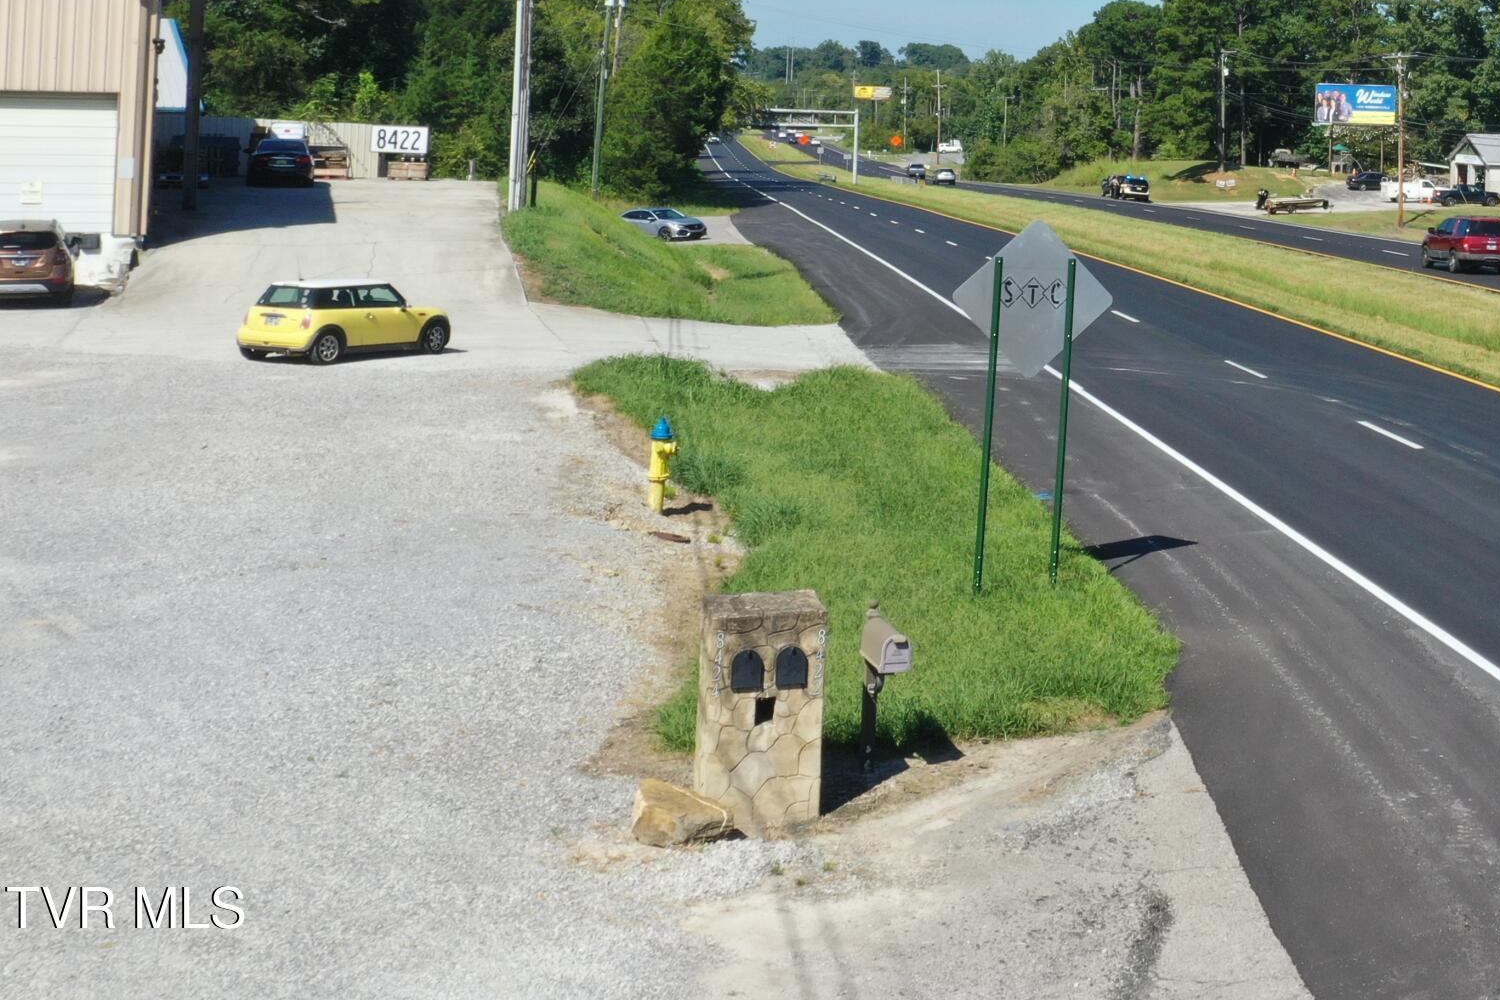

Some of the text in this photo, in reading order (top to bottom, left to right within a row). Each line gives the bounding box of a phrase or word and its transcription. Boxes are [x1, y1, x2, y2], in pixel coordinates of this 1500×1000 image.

[376, 128, 422, 151] 8422
[1004, 279, 1061, 305] STC
[711, 632, 725, 697] 8424
[808, 629, 826, 696] 8422
